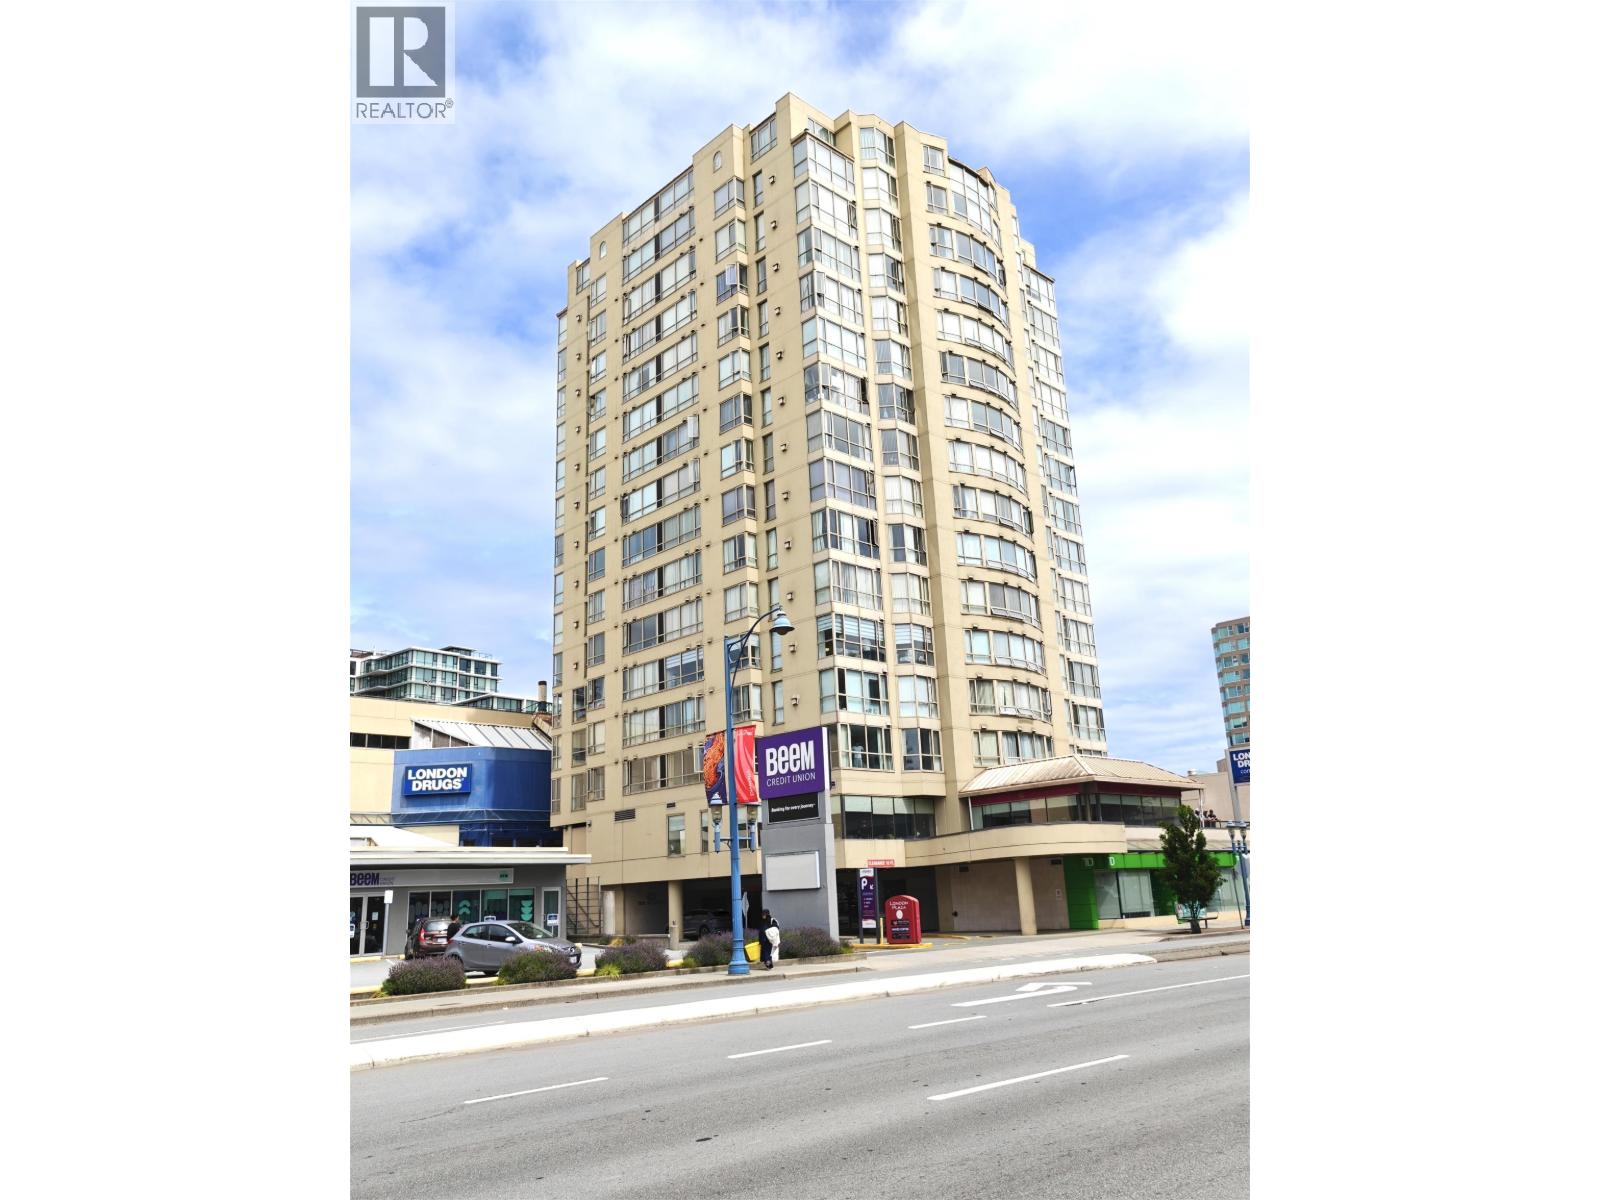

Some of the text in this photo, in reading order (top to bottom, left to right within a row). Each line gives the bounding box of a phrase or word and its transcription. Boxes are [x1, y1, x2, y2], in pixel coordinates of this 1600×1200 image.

[407, 767, 468, 780] LONDON
[766, 772, 816, 787] CREDIT UNION
[411, 779, 462, 791] DRUGS
[861, 877, 868, 890] P
